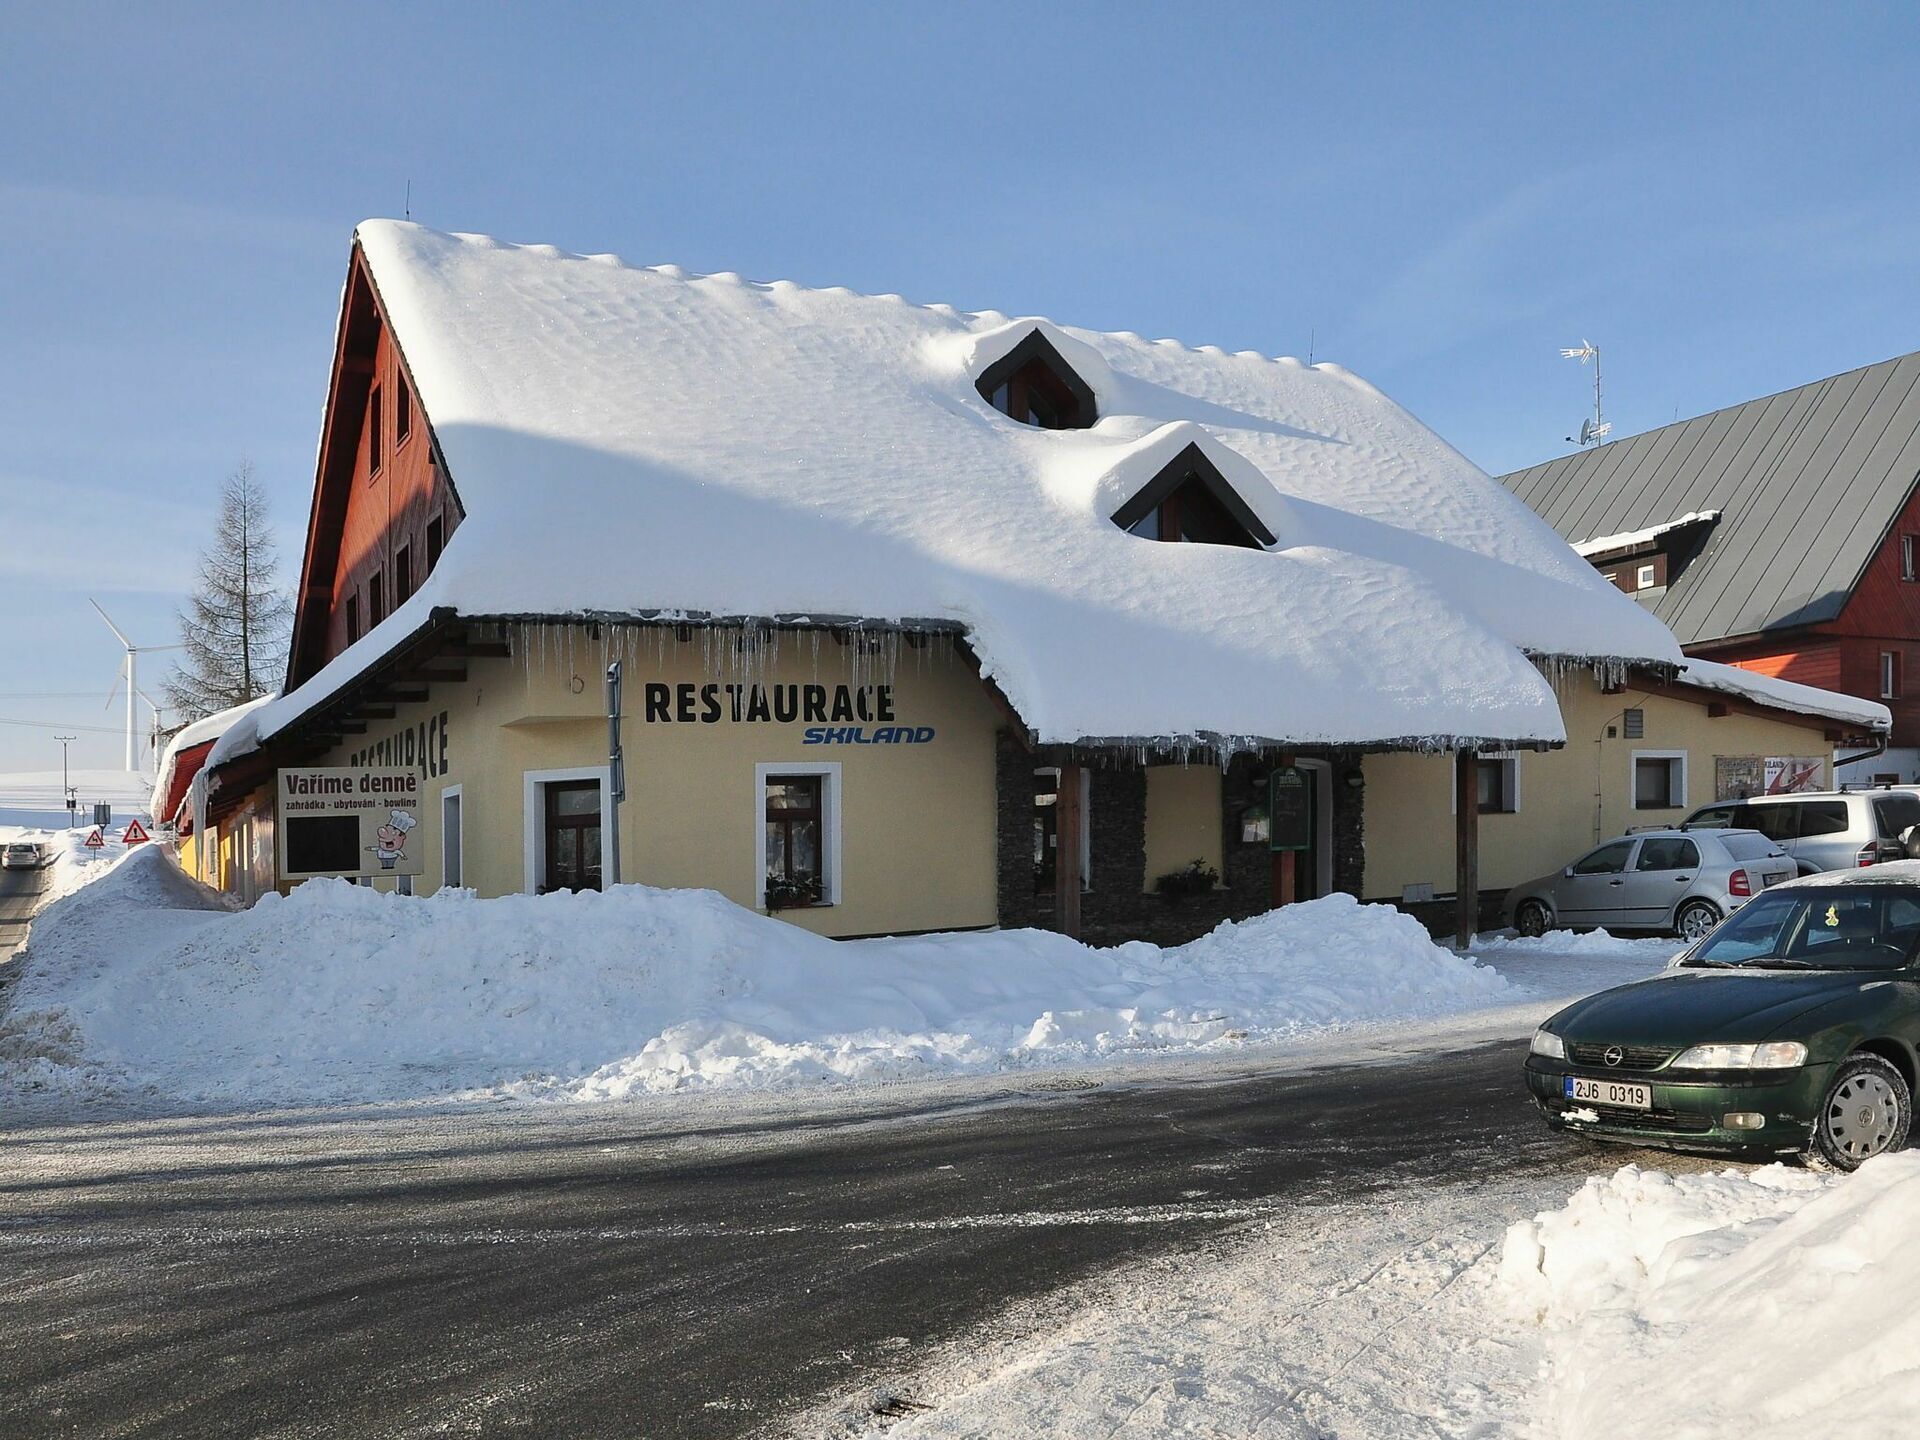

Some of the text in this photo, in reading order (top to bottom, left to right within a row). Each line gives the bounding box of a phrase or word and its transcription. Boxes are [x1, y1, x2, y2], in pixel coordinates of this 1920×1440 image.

[645, 683, 895, 723] RESTAURACE
[351, 710, 448, 781] TAURACE
[802, 727, 935, 744] SKILAND
[285, 772, 416, 795] Vaříme denně
[384, 798, 417, 808] bowling
[1575, 1081, 1644, 1104] 2J6 0319
